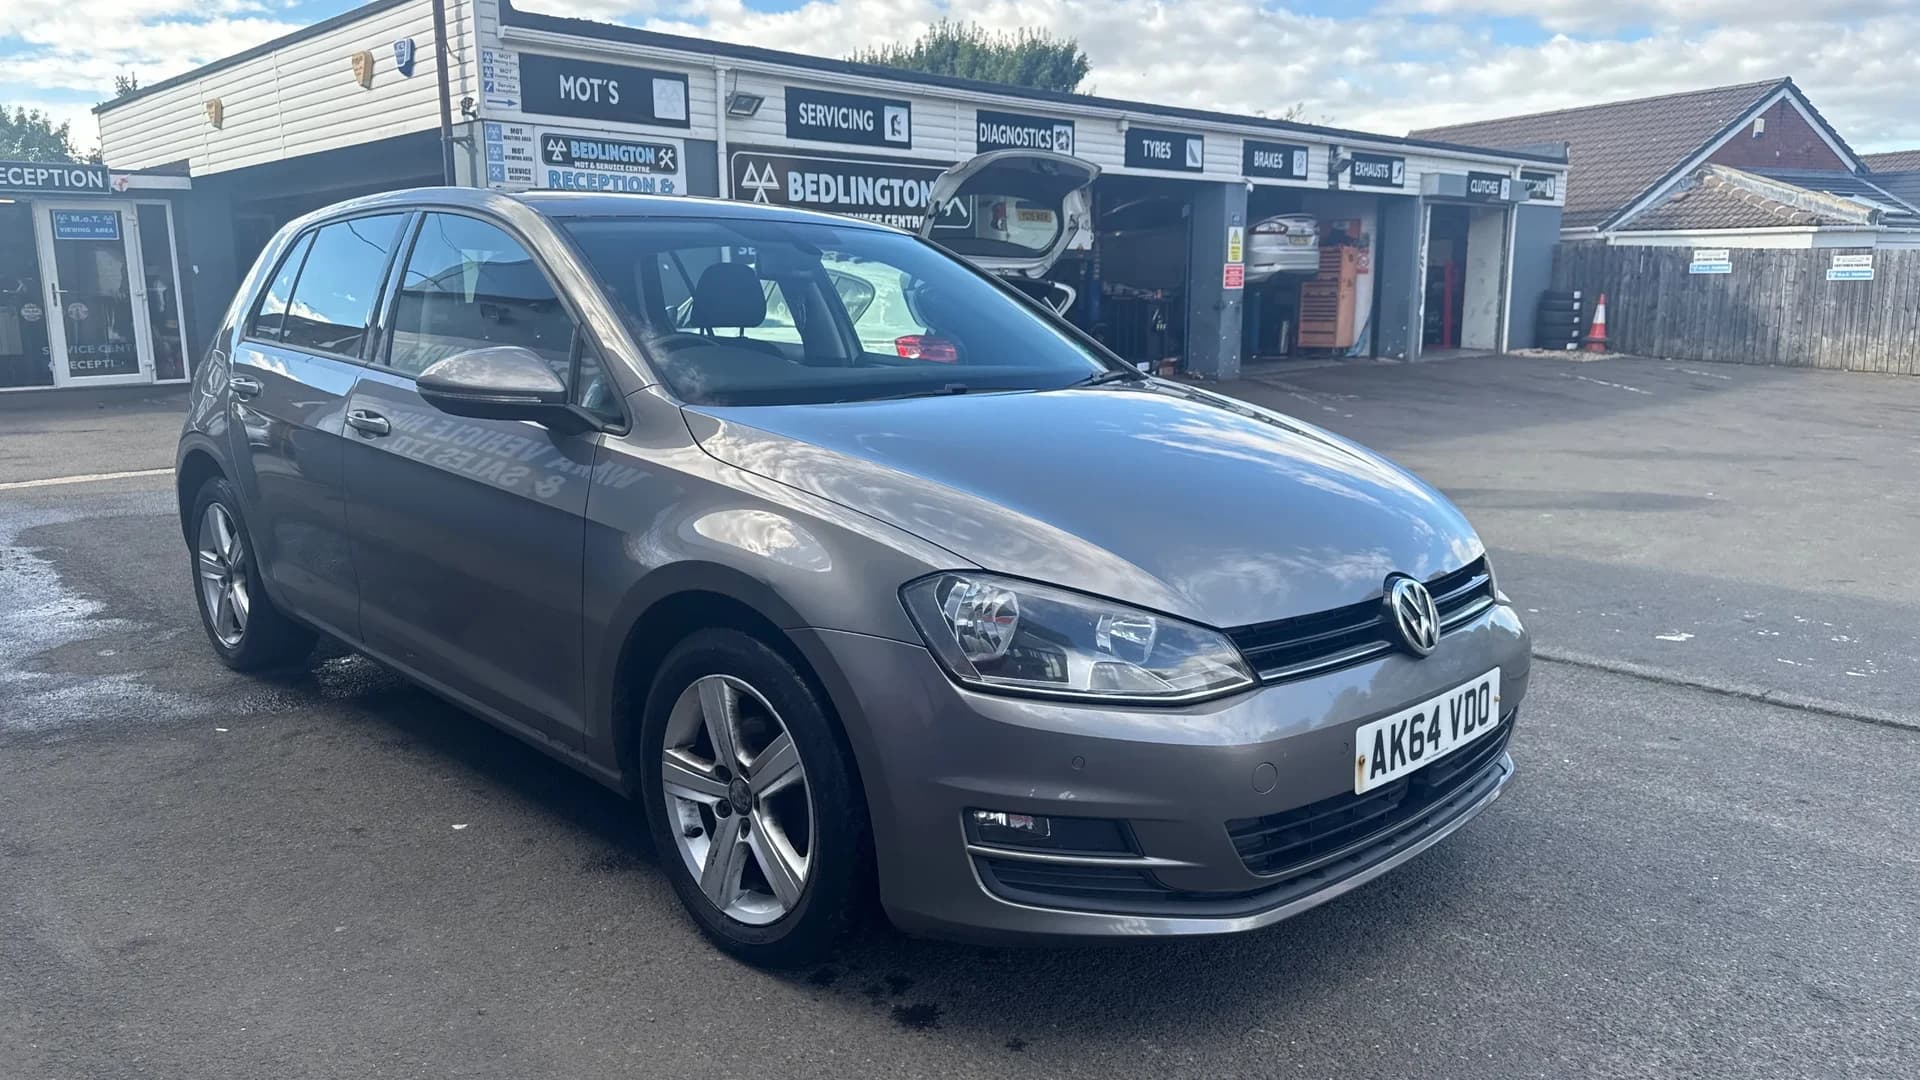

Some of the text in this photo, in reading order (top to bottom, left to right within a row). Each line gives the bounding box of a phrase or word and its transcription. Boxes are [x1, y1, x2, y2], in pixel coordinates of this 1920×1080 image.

[559, 74, 619, 104] MOT'S
[798, 102, 874, 131] SERVICING
[979, 122, 1051, 148] DIAGNOSTICS
[570, 140, 655, 164] BEDLINGTON
[1142, 139, 1172, 159] TYRES
[1254, 152, 1283, 169] BRAKES
[596, 163, 625, 171] SERVICE
[625, 165, 650, 173] CENTRE
[1355, 159, 1389, 178] EXHAUSTS
[548, 170, 675, 194] RECEPTION &
[788, 171, 936, 207] BEDLINGTON
[1470, 179, 1499, 194] CLUTCHES
[42, 344, 95, 355] SVICE
[1369, 681, 1490, 780] AK64 VDO
